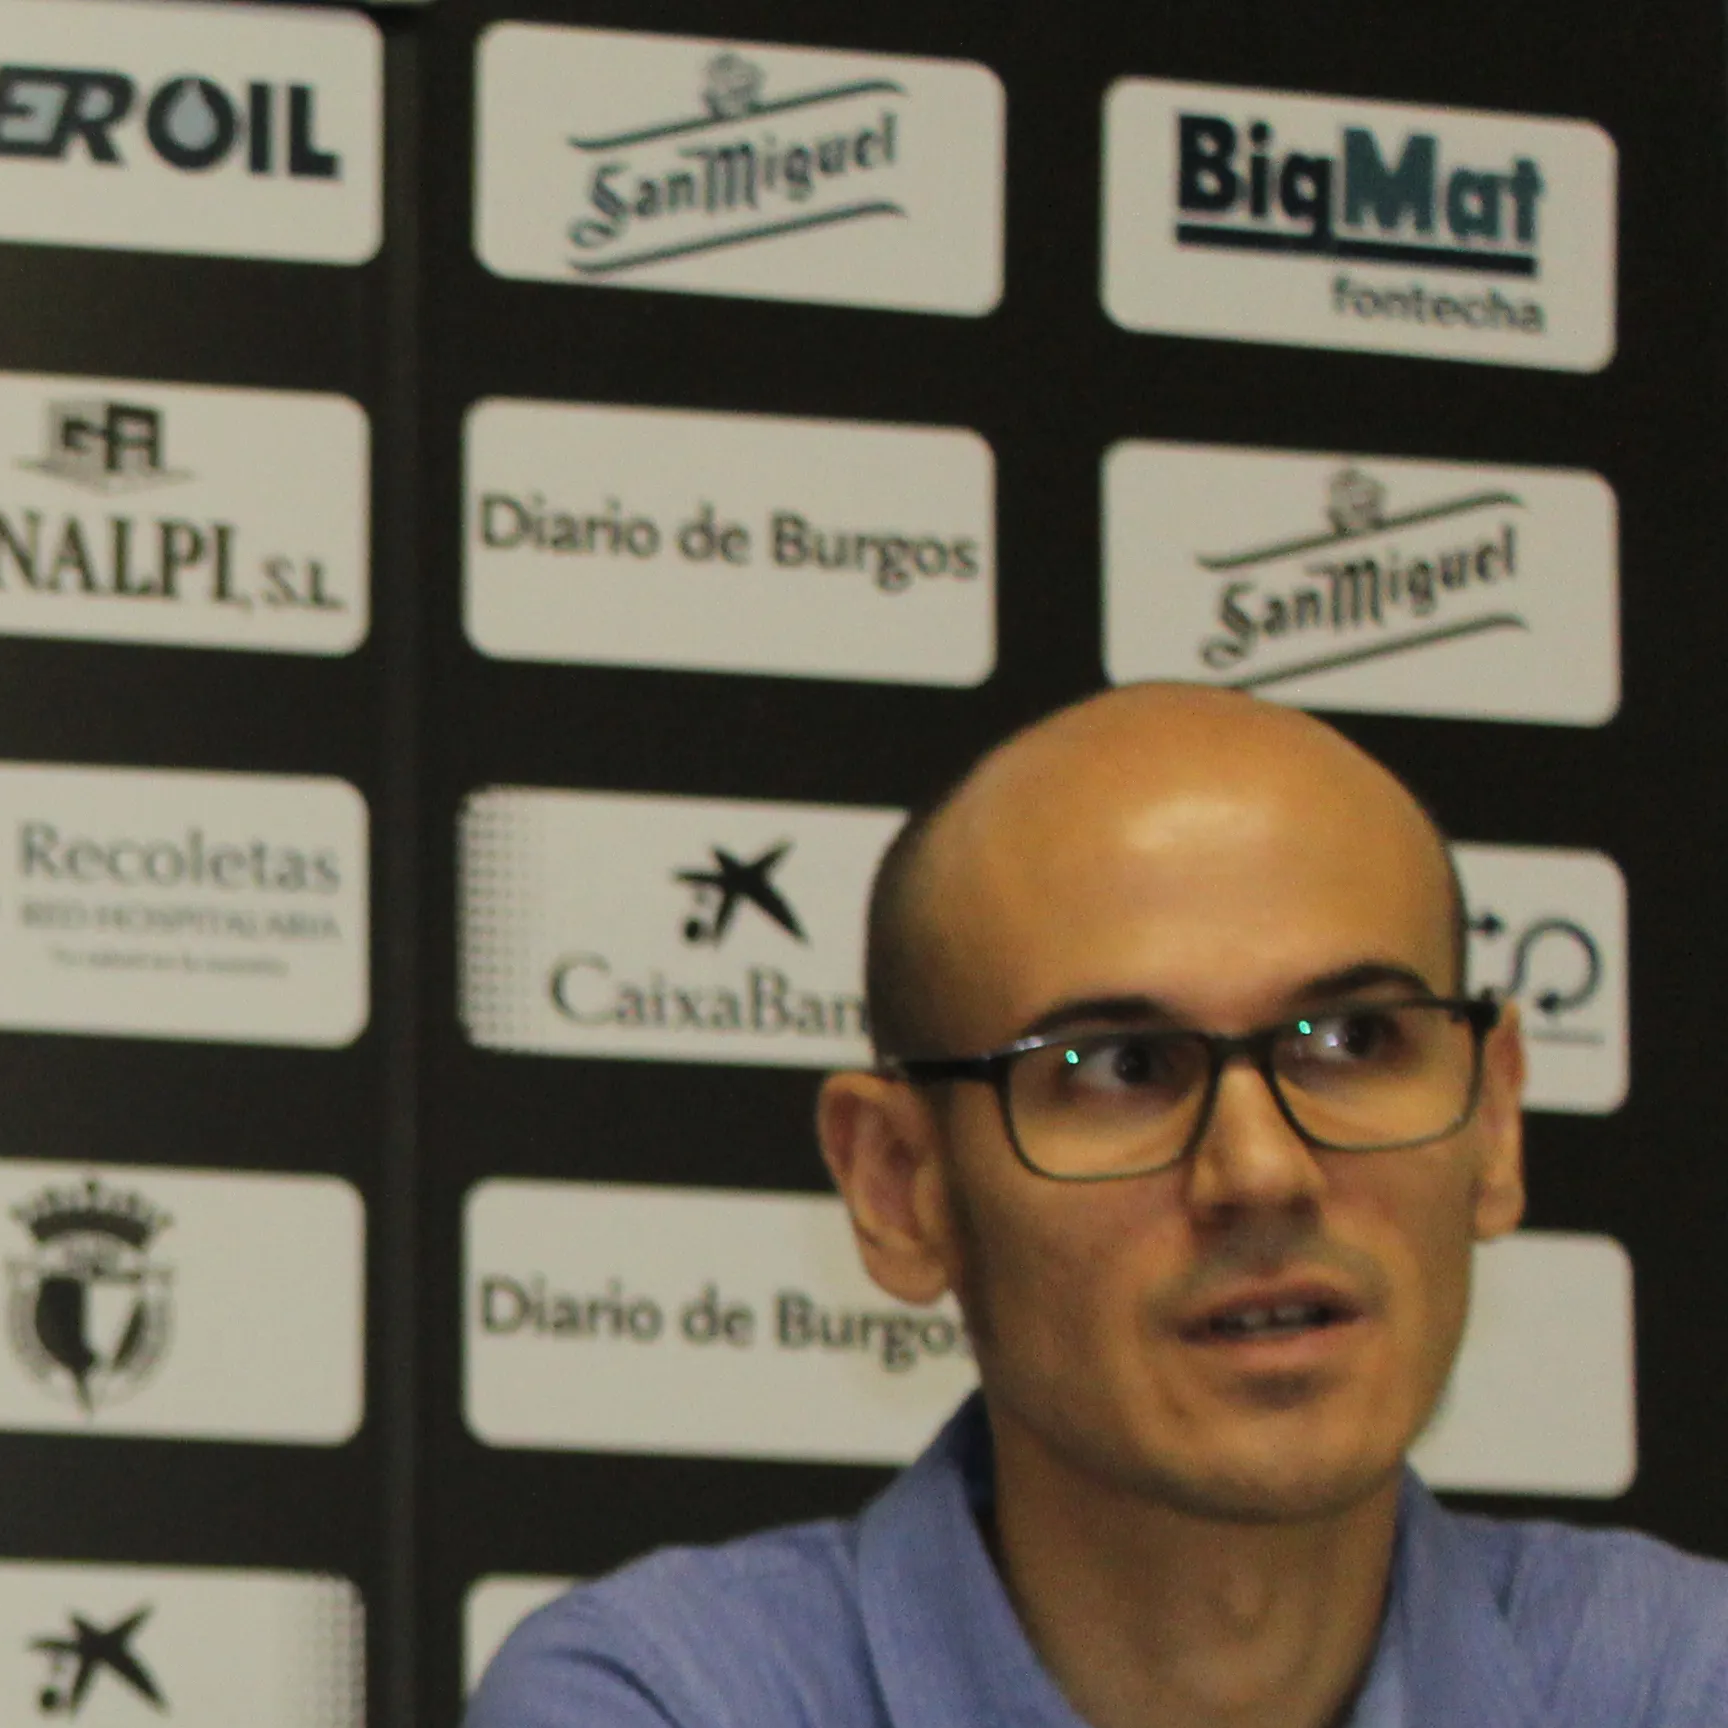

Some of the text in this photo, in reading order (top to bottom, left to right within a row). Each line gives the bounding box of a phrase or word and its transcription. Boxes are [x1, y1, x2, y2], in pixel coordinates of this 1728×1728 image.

[1175, 112, 1544, 245] BigMat
[1332, 277, 1545, 333] fontecha
[480, 494, 980, 590] Diario de Burgos
[19, 820, 342, 894] Recoletas
[550, 955, 870, 1036] CaixaBan
[479, 1278, 970, 1374] Diario de Burgo
